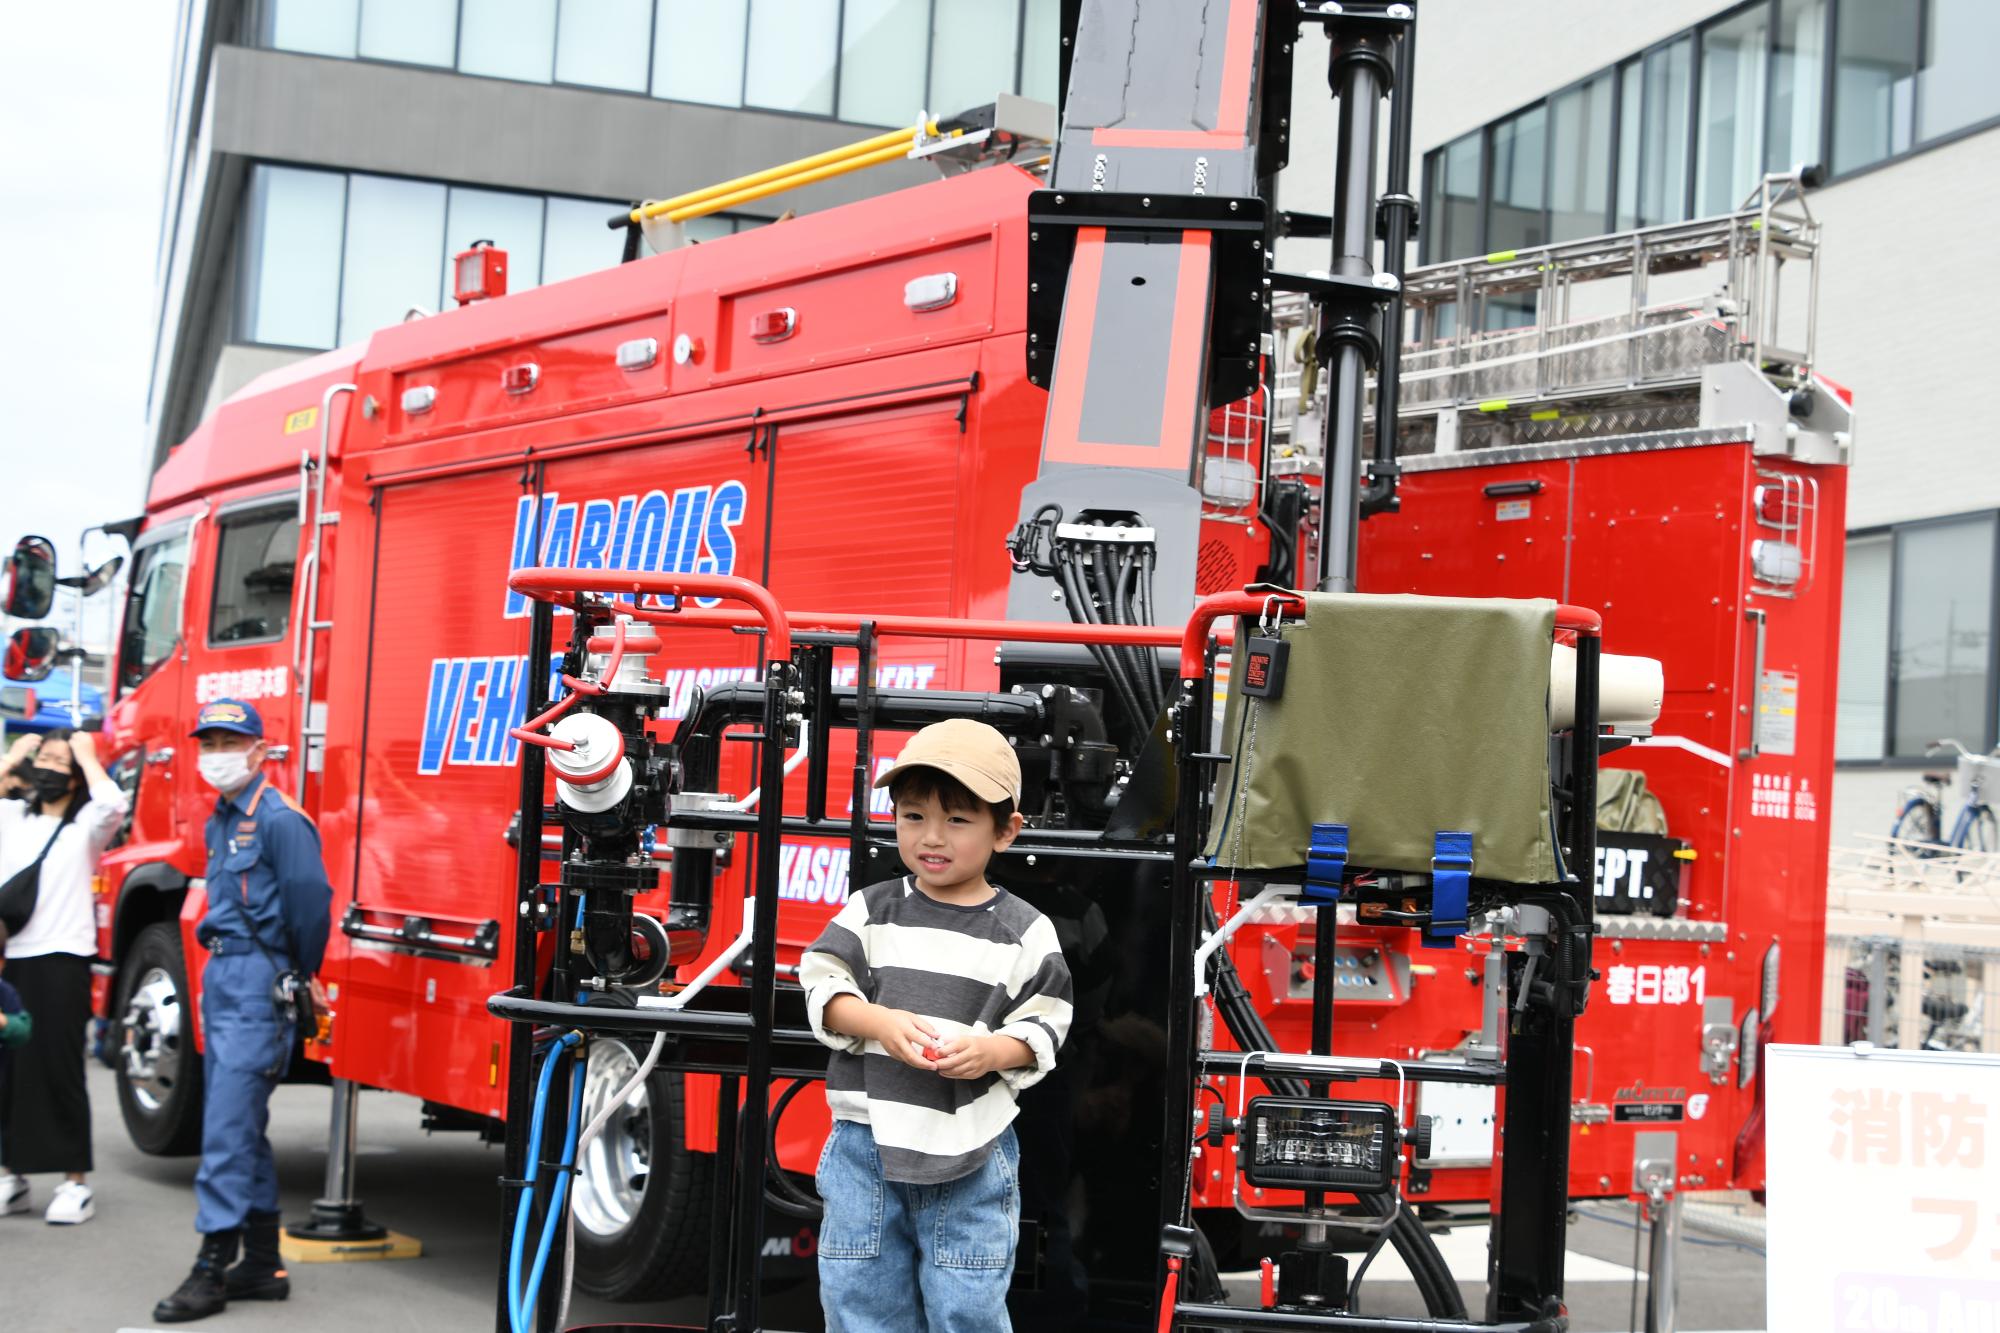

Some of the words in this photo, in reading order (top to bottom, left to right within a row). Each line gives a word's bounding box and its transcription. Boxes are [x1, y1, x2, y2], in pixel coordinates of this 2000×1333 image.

[503, 479, 747, 619] VARIOUS
[1593, 846, 1653, 899] EPT.
[1606, 963, 1706, 1006] 春日部1
[1828, 1087, 1988, 1170] 消防
[1911, 1196, 2000, 1262] フ
